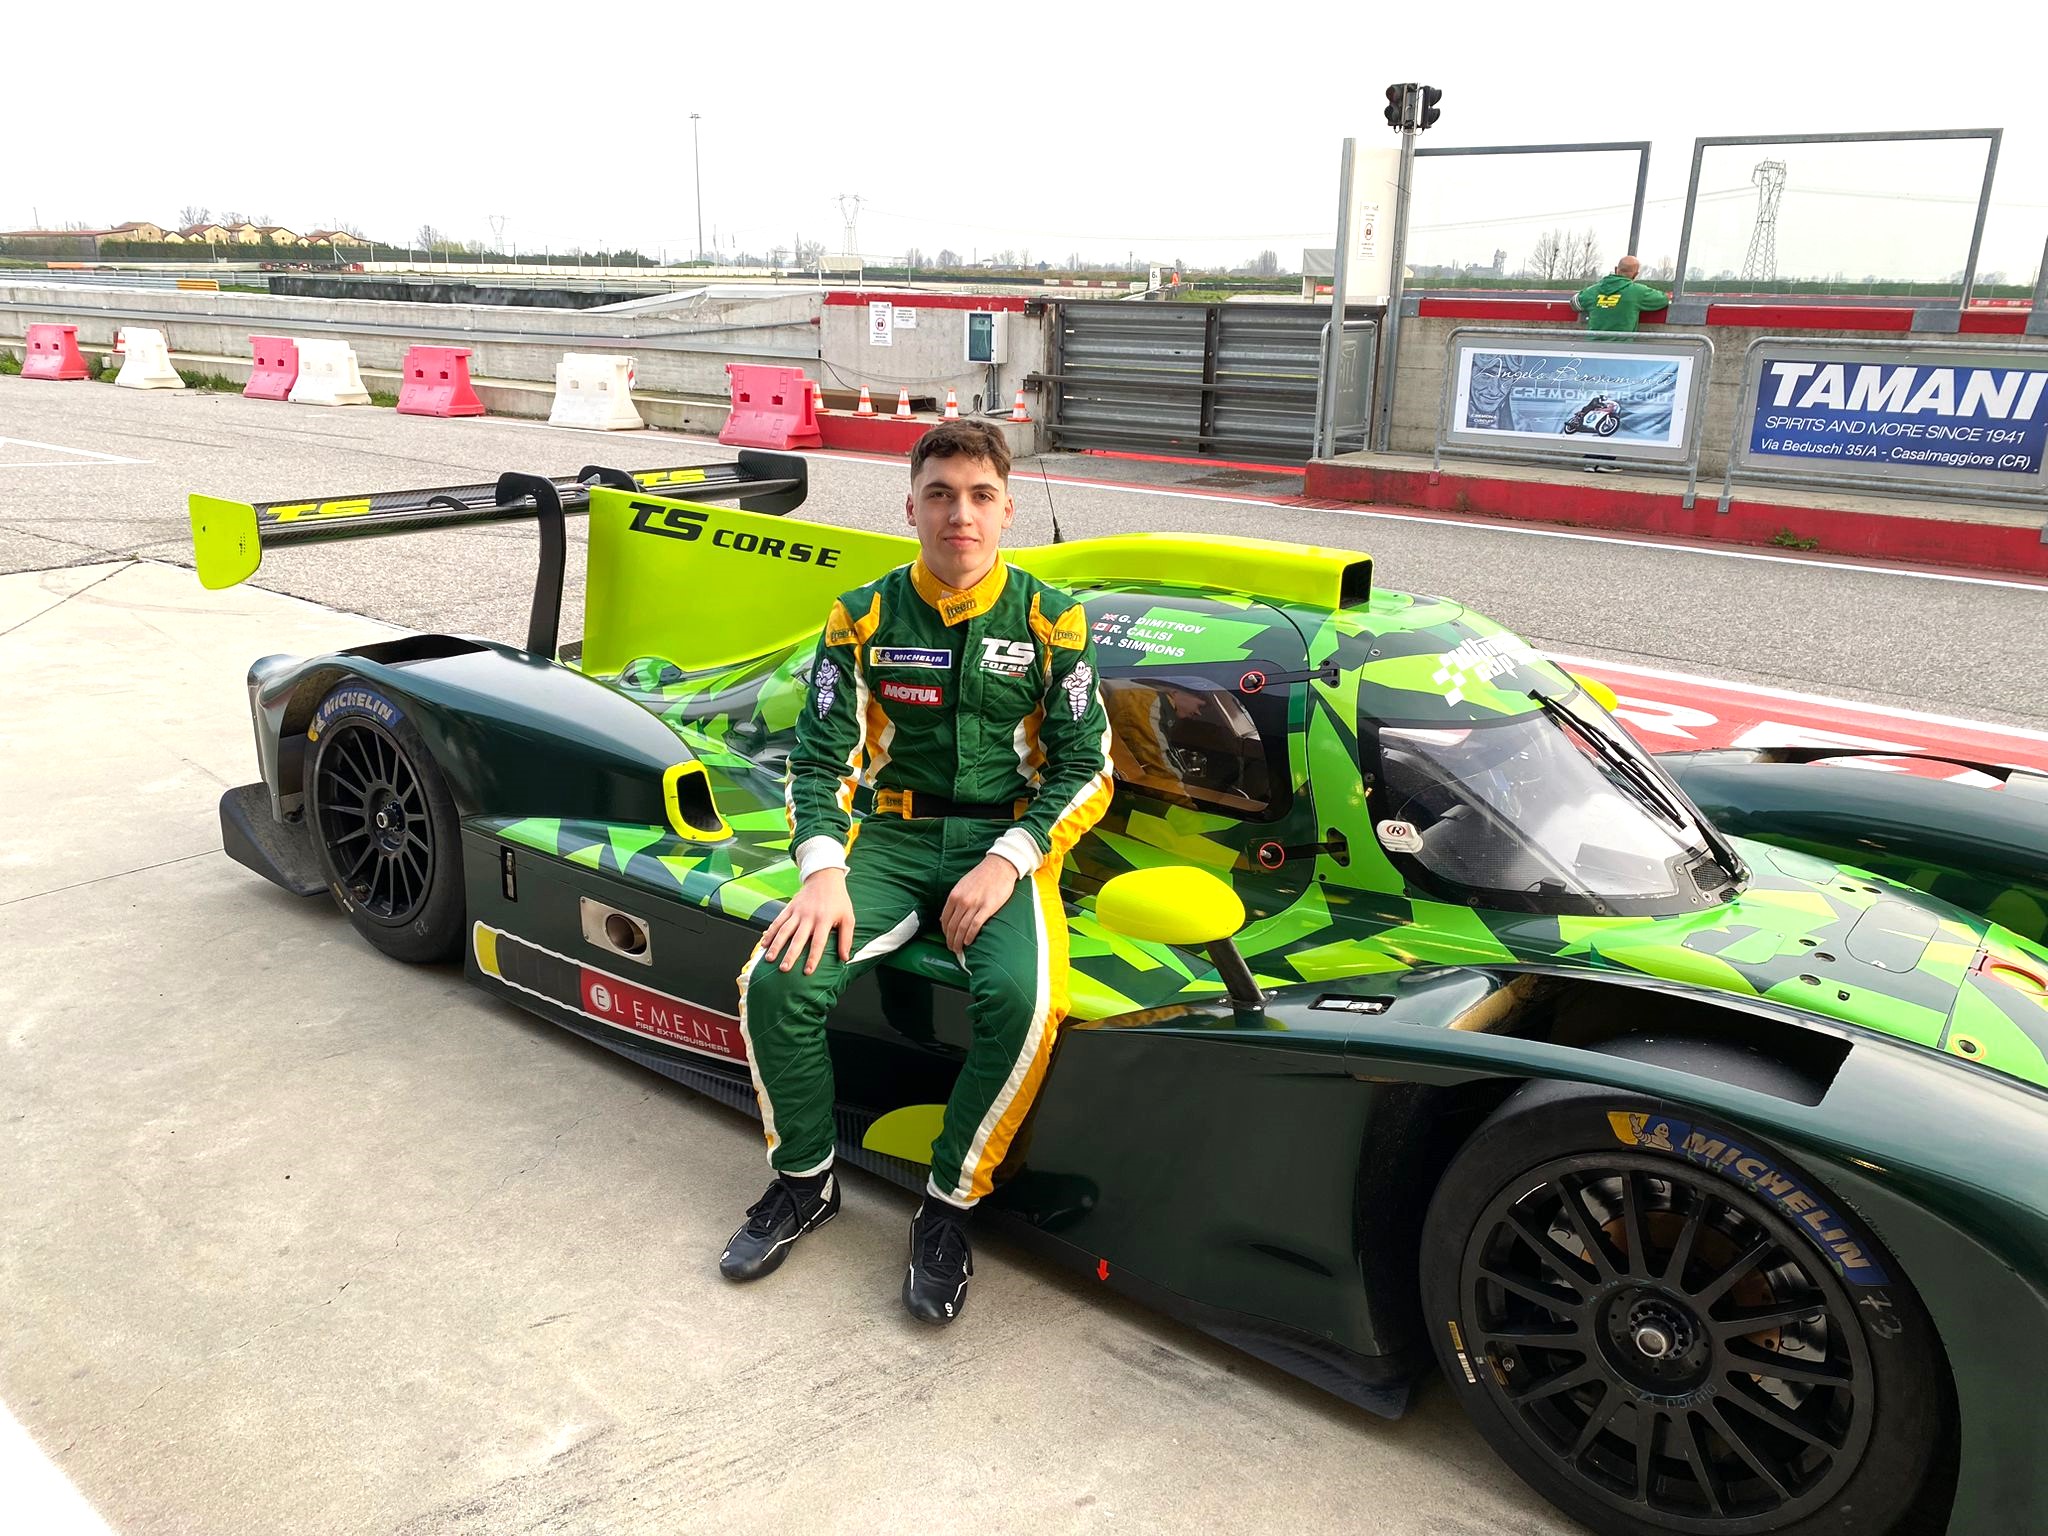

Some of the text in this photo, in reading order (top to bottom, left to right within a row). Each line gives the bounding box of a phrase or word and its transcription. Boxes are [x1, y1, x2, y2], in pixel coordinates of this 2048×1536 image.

[1473, 357, 1547, 389] Angelo
[1770, 362, 2047, 420] TAMANI
[1765, 415, 2026, 445] SPIRITS AND MORE SINCE 1941
[1760, 437, 1780, 451] Via
[1782, 440, 1843, 455] Beduschi
[1845, 444, 1878, 458] 35/A
[1890, 446, 1995, 467] Casalmaggiore
[1997, 453, 2031, 471] (CR)
[633, 469, 706, 486] TS
[266, 498, 371, 523] TS
[628, 501, 841, 569] TS CORSE
[1109, 624, 1174, 642] R. CALISI
[1118, 614, 1207, 634] G. DIMITROV
[893, 654, 943, 663] MICHELIN
[981, 637, 1036, 666] TS
[1100, 635, 1185, 657] A. SIMMONS
[979, 660, 1029, 673] corse
[323, 692, 394, 721] MICHELIN
[883, 684, 939, 702] MOTUL
[592, 984, 729, 1046] ELEMENT
[635, 1020, 731, 1054] FIRE EXTINGUISHERS
[1681, 1131, 1872, 1269] MICHELIN
